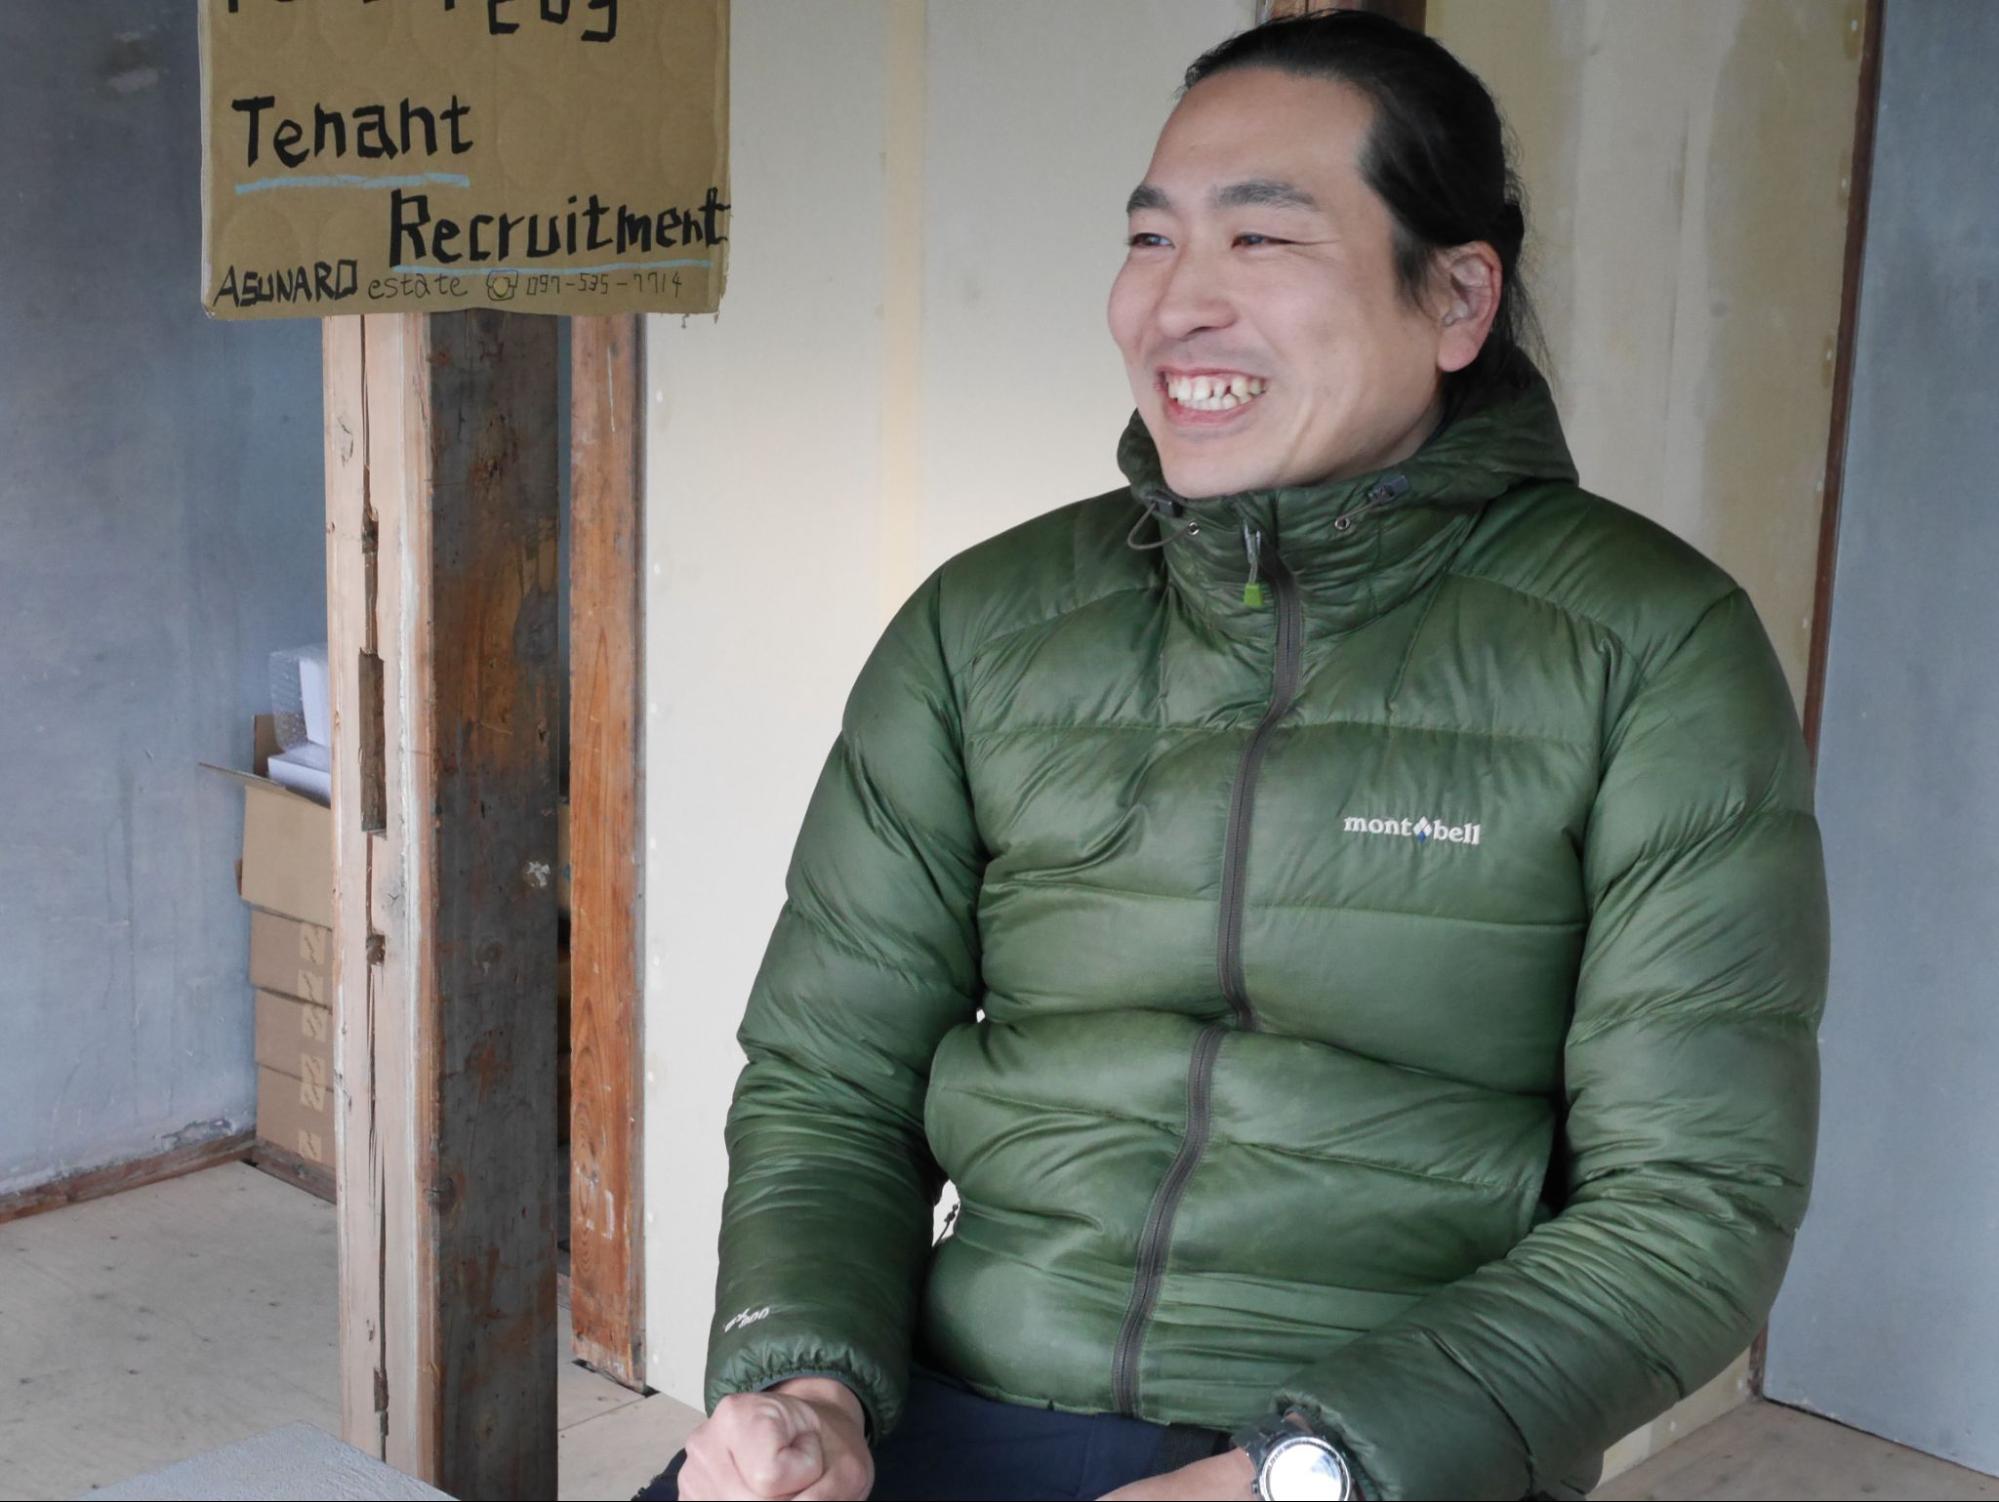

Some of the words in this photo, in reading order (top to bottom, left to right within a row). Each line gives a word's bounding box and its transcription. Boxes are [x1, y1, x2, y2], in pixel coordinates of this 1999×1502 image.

[232, 95, 474, 169] Tenant
[388, 186, 731, 268] Recruitment
[368, 272, 468, 300] estate
